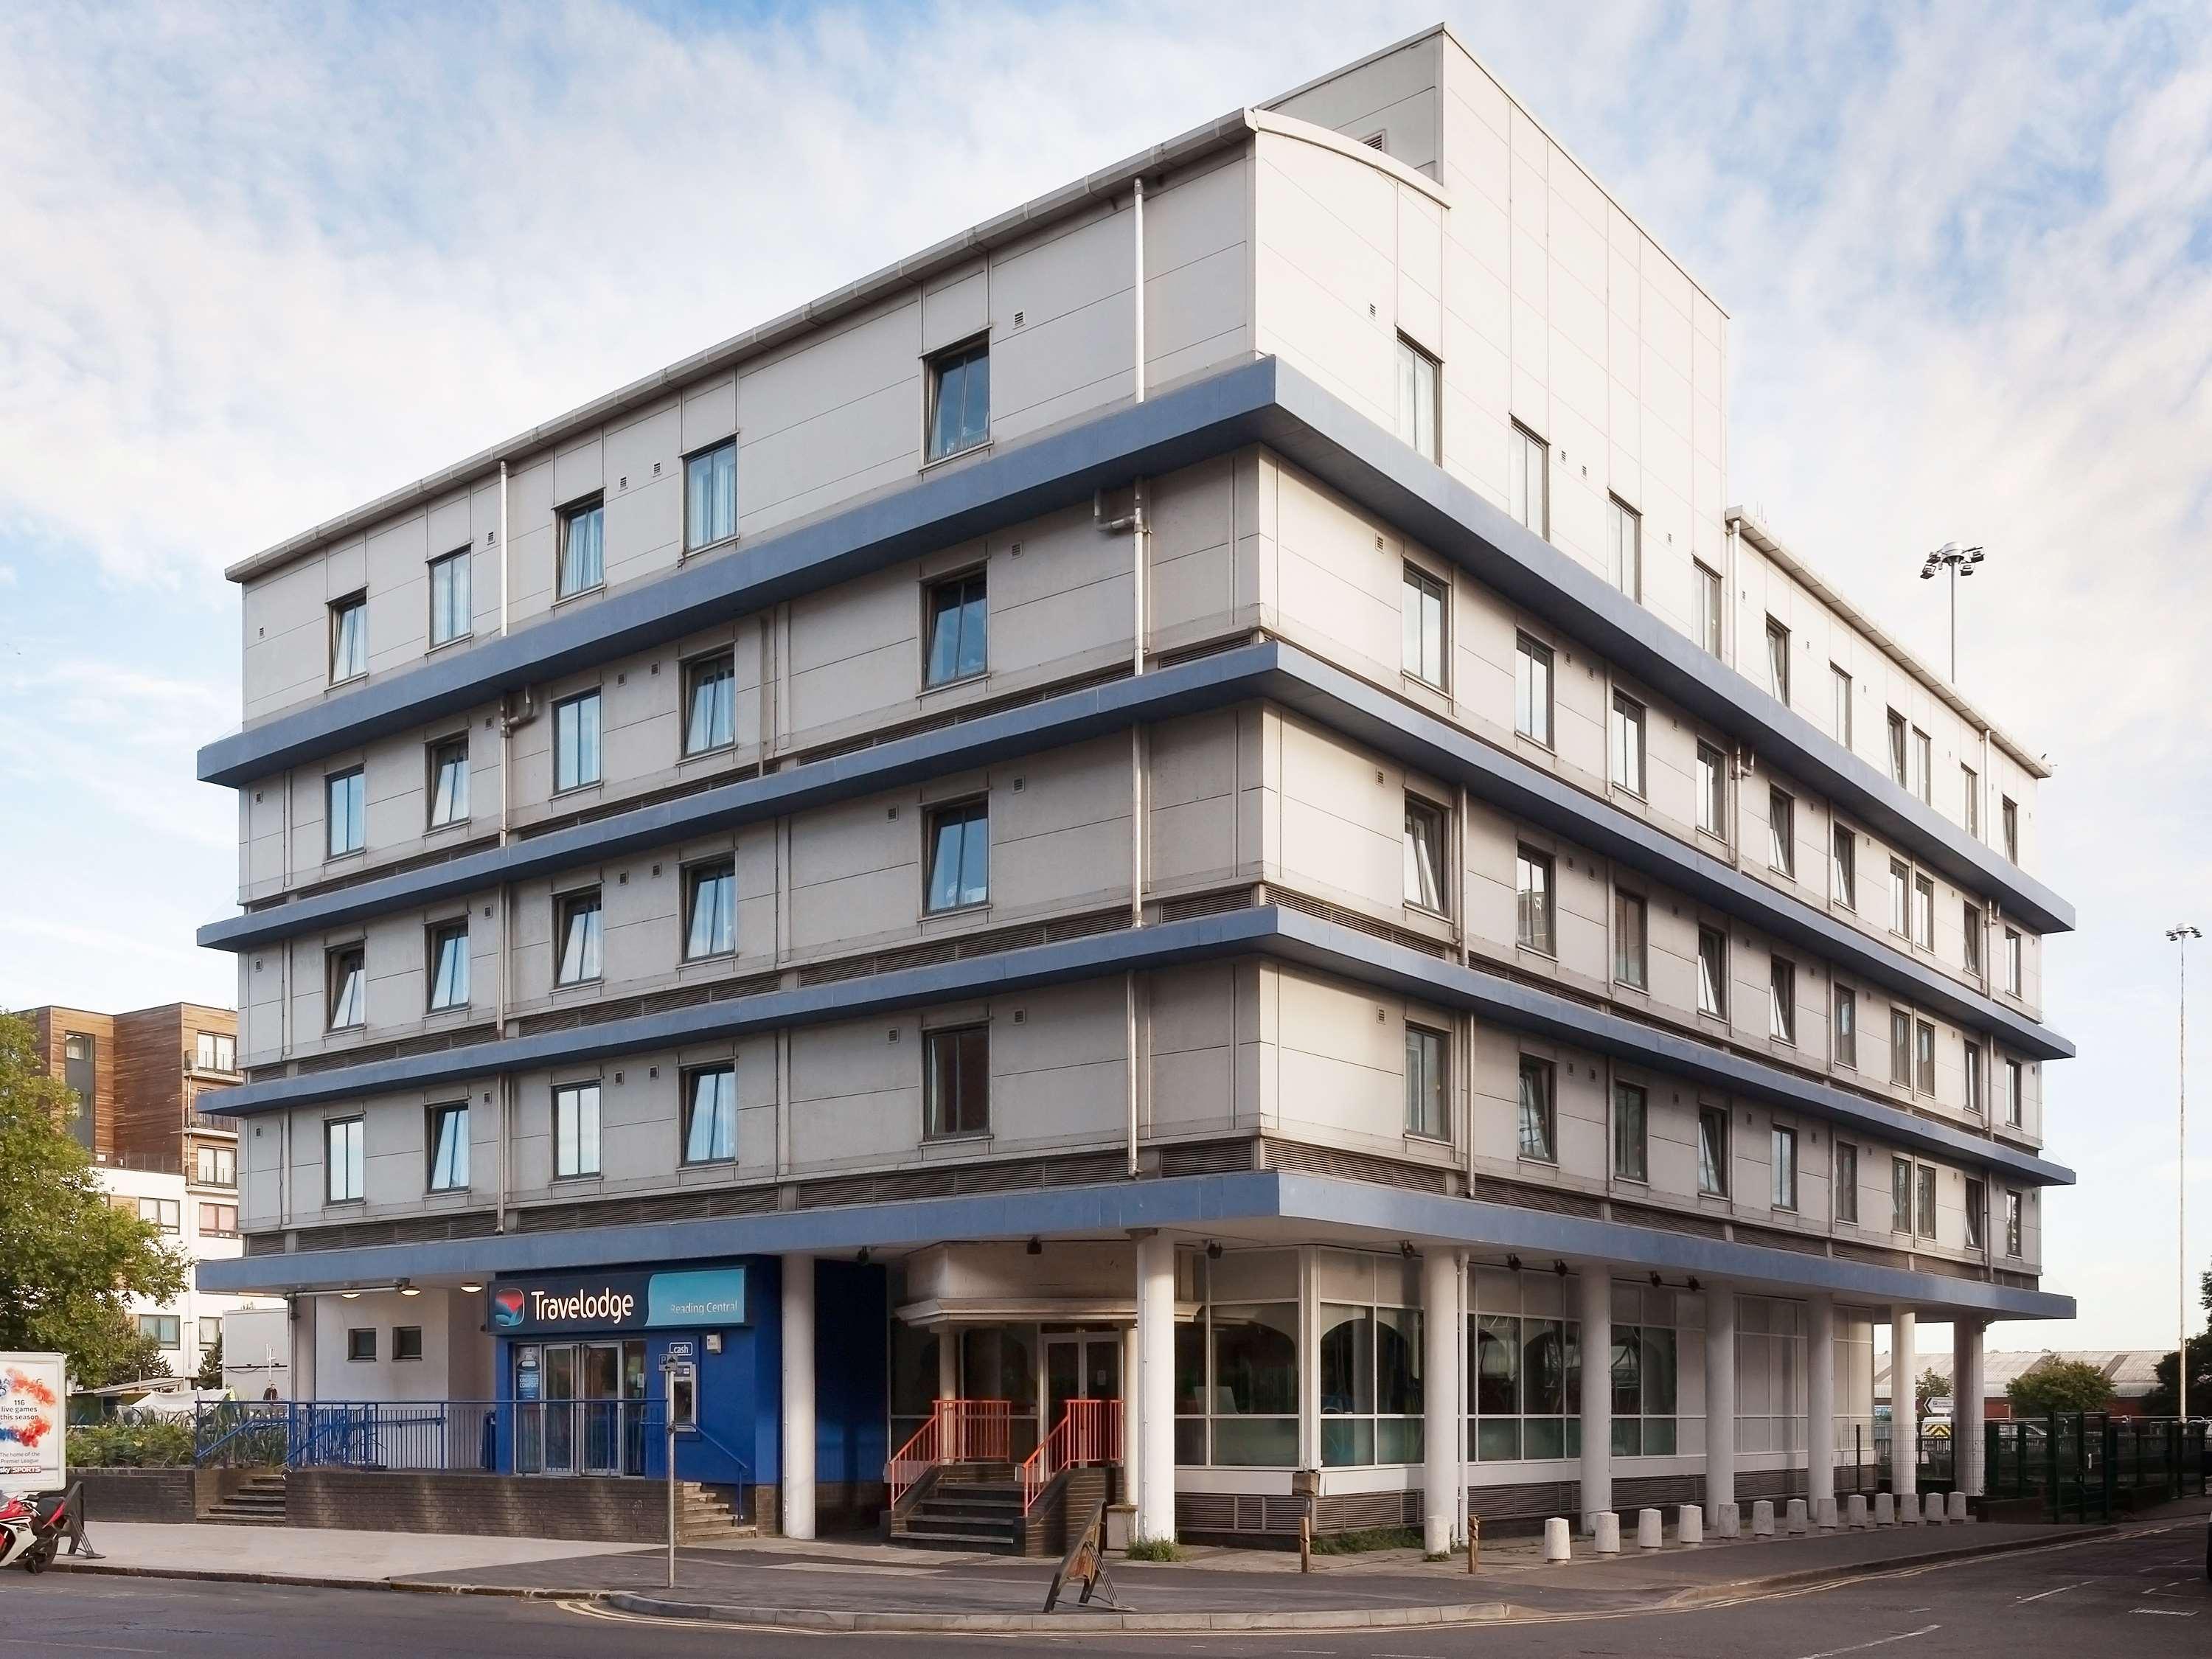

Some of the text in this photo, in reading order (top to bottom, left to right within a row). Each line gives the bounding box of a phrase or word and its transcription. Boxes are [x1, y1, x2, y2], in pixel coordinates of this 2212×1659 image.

[531, 1287, 634, 1324] Travelodge
[671, 1299, 737, 1315] Reading Central
[673, 1344, 689, 1354] cash
[661, 1356, 667, 1365] P
